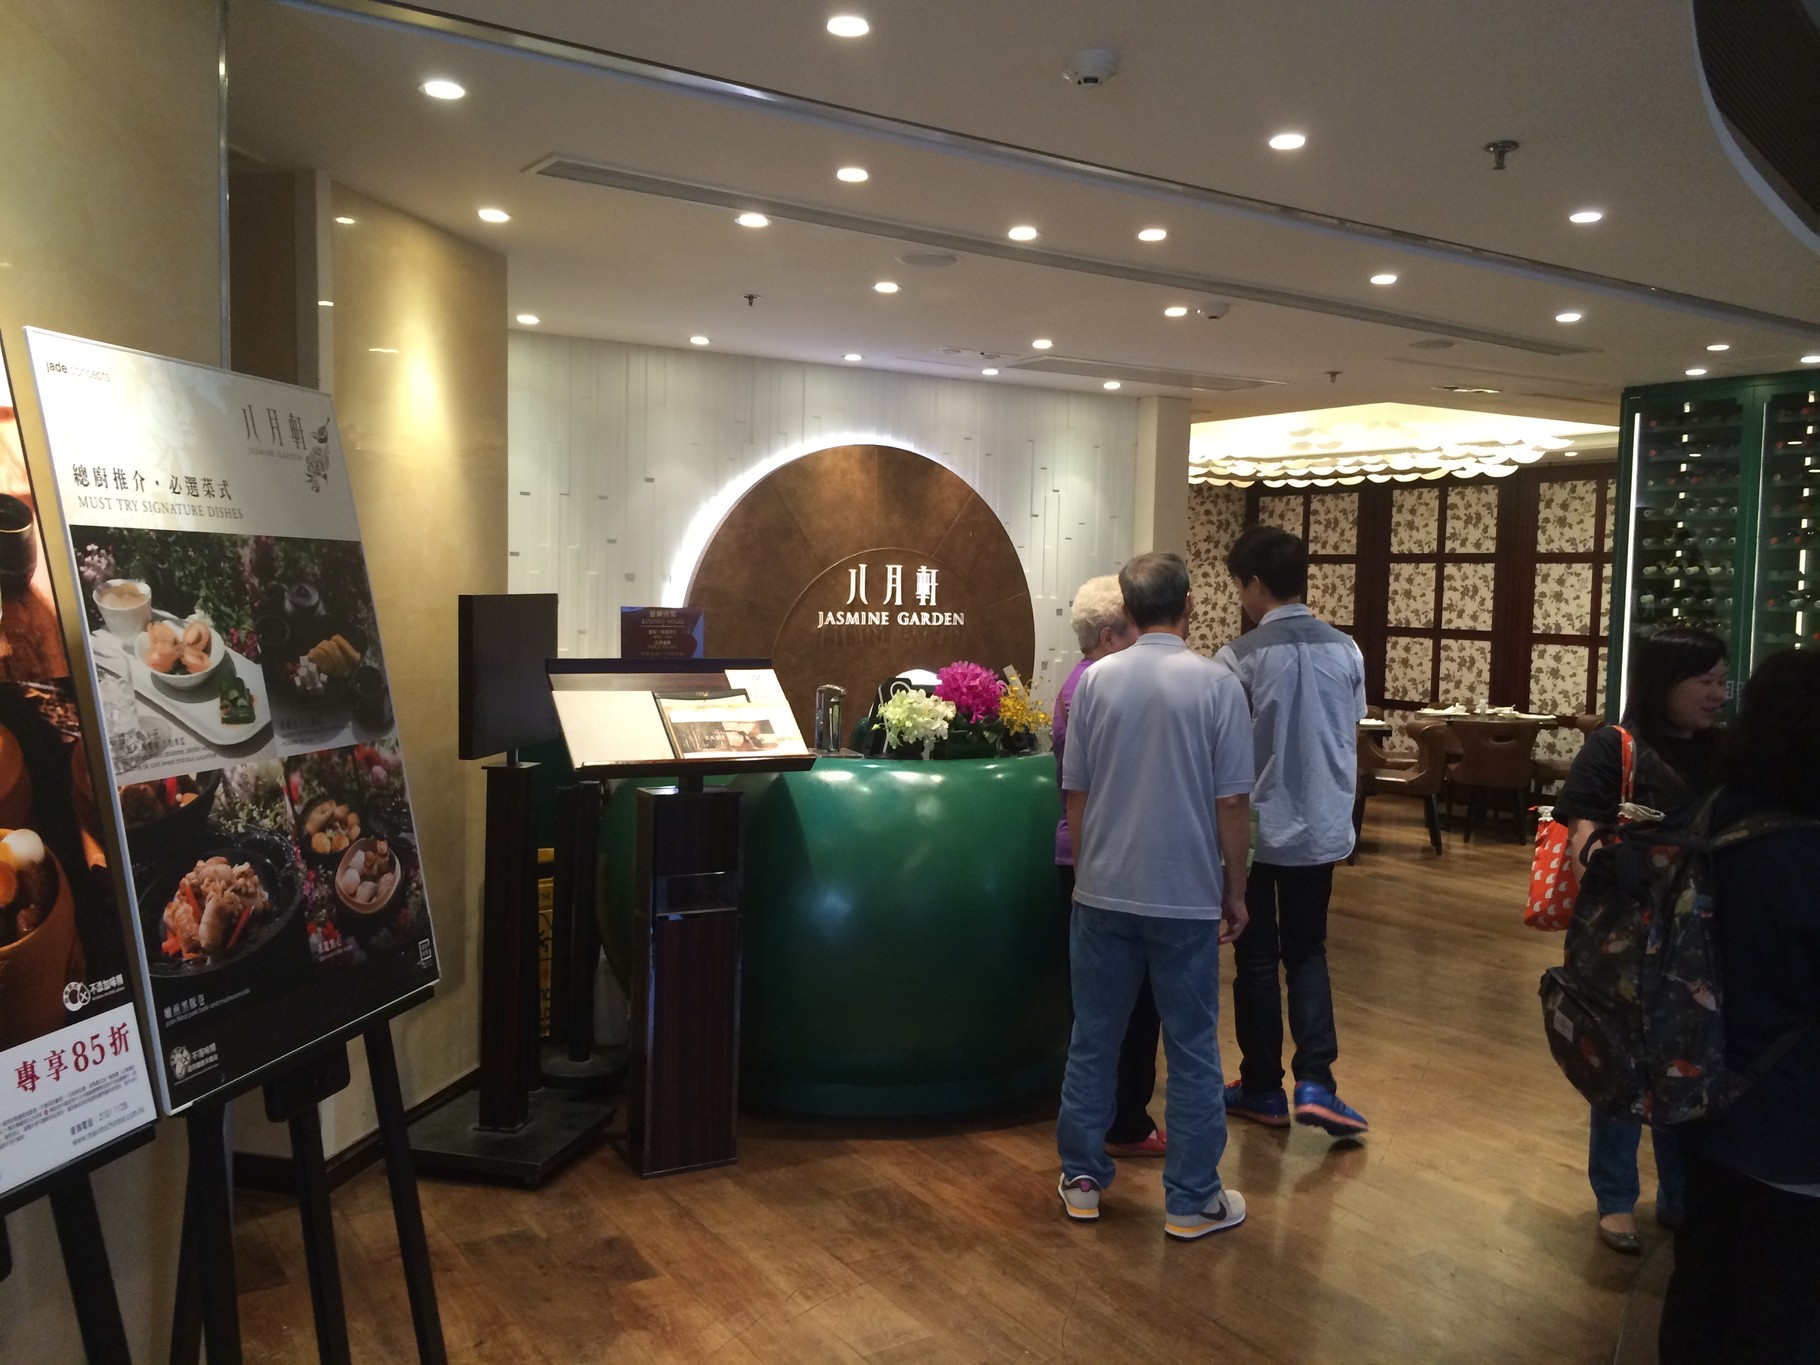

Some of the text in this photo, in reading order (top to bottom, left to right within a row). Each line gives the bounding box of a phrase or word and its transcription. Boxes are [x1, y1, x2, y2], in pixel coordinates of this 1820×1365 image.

[45, 359, 68, 374] jade
[241, 404, 307, 451] 八月軒
[77, 495, 244, 520] MUST TRY SIGNATURE DISHES
[846, 563, 940, 607] 八月軒
[817, 611, 966, 629] JASMINE GARDEN
